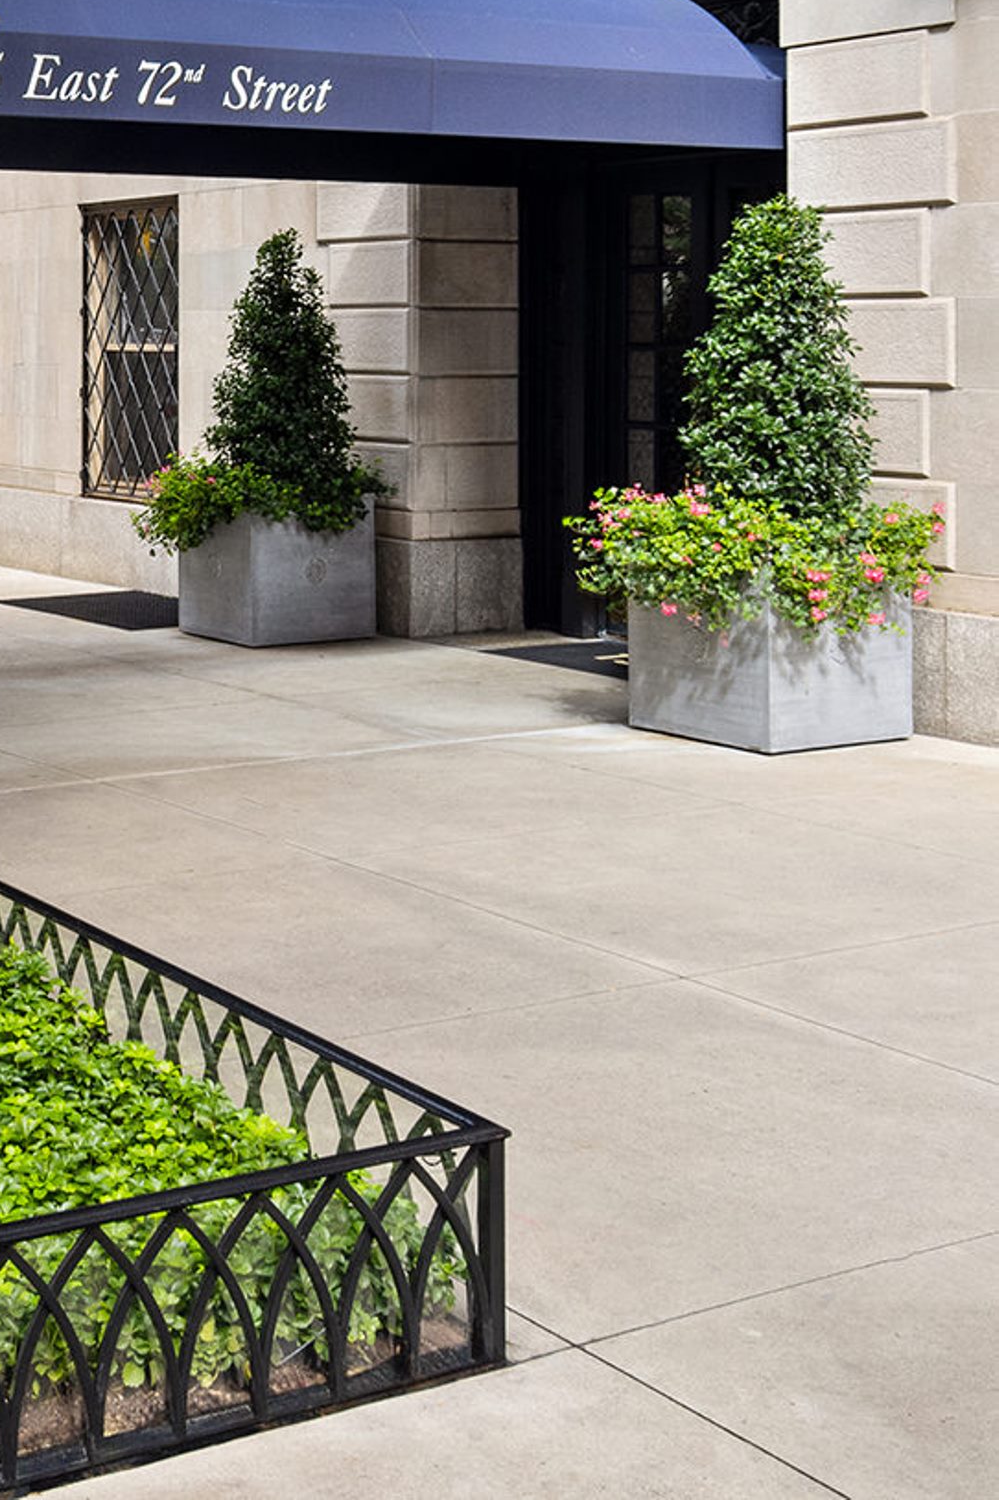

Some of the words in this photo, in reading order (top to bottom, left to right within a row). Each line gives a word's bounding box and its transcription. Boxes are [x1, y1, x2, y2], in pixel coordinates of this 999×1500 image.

[22, 53, 120, 102] East
[137, 59, 206, 107] 72nd
[221, 64, 334, 115] Street
